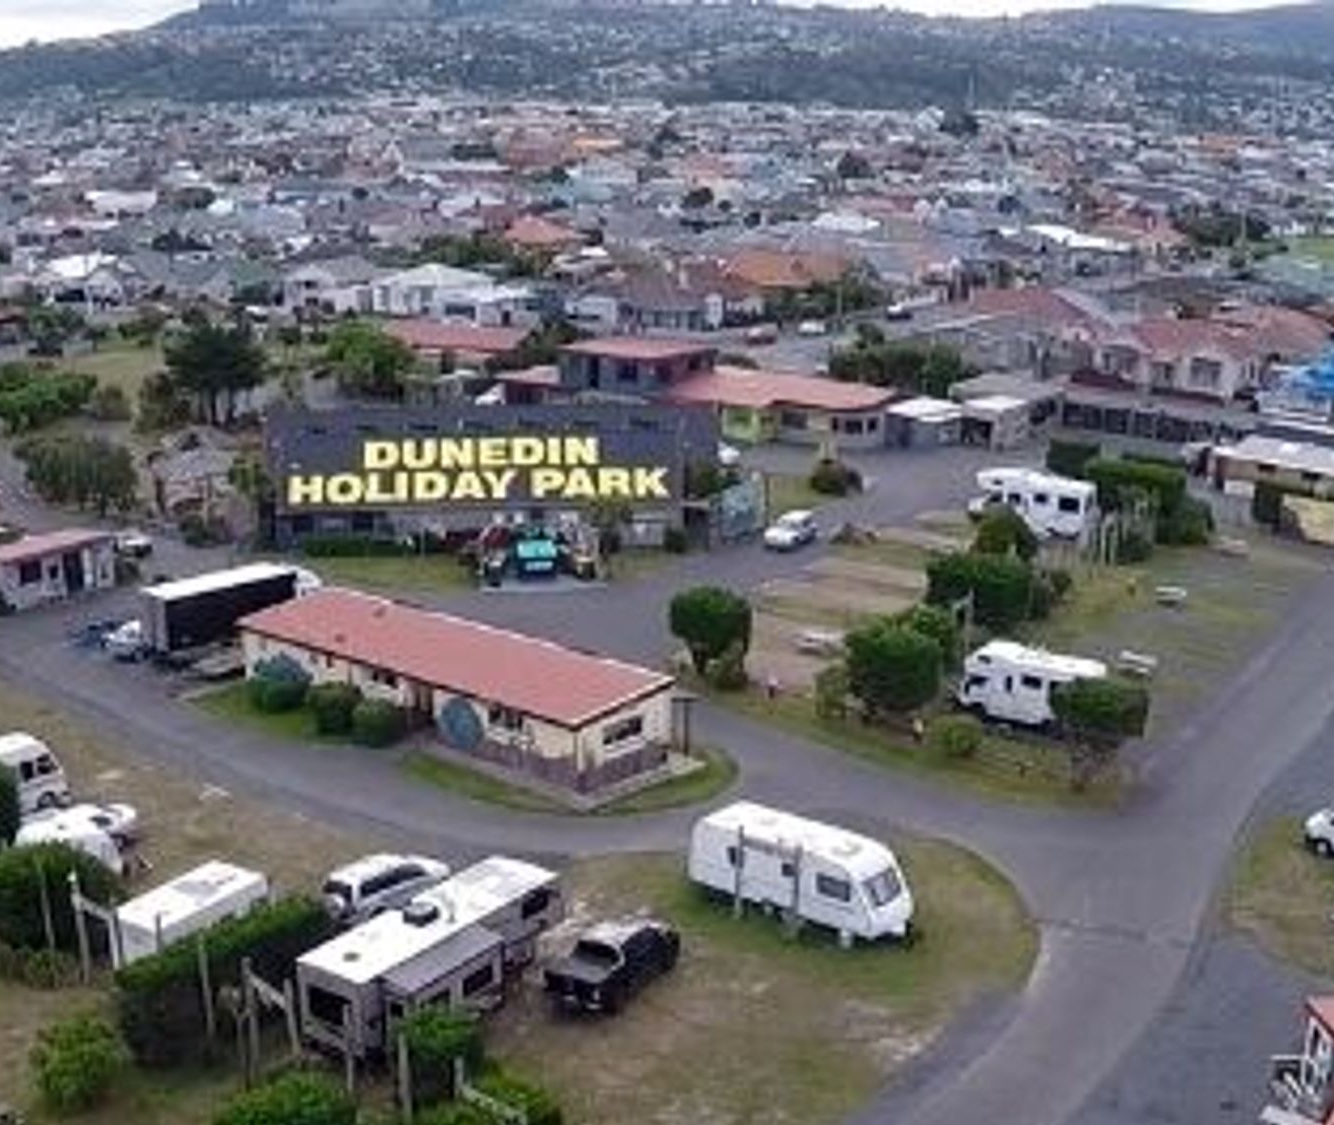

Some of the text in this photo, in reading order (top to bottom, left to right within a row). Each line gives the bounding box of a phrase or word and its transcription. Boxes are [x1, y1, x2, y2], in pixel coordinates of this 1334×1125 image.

[363, 436, 599, 468] DUNEDIN
[287, 466, 667, 504] HOLIDAY PARK
